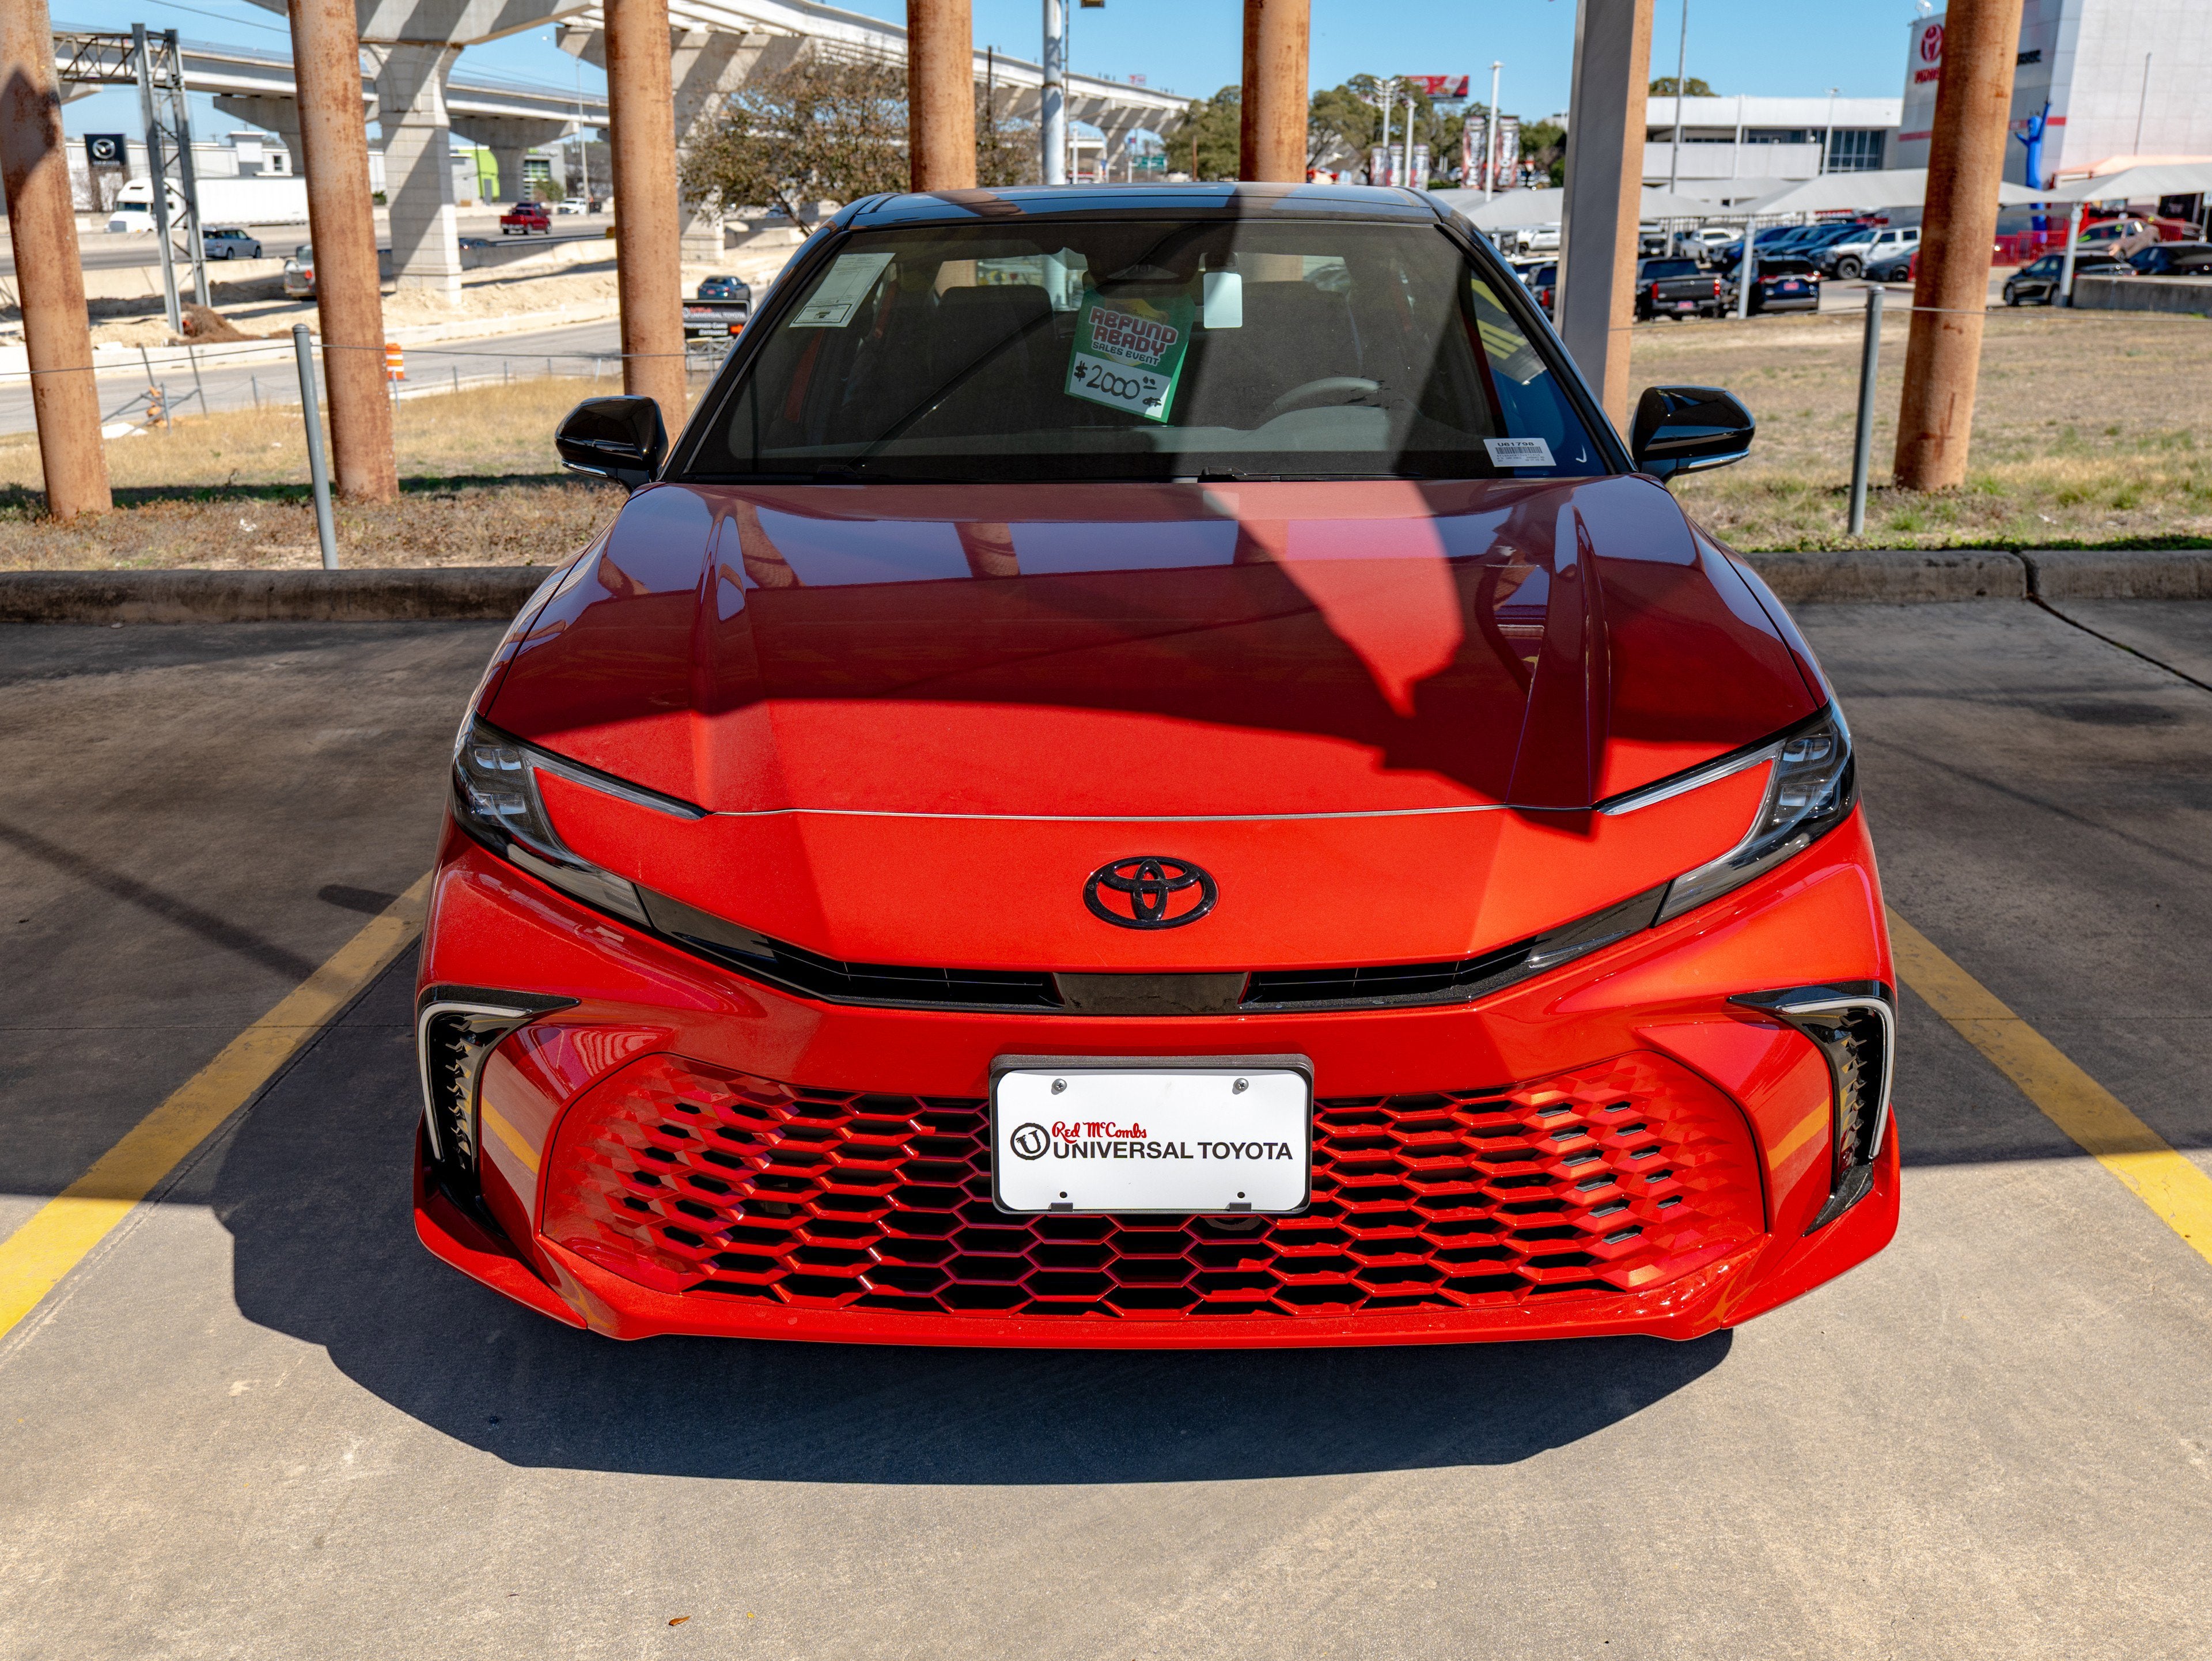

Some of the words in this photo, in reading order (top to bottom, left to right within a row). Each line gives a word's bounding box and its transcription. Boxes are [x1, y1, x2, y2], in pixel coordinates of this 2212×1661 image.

[1090, 307, 1177, 343] REFUND
[1093, 326, 1166, 357] READY
[1093, 342, 1123, 355] SALES
[1126, 350, 1160, 365] EVENT
[1052, 1121, 1081, 1144] Red
[1082, 1122, 1147, 1138] McCombs
[1054, 1141, 1194, 1159] UNIVERSAL
[1197, 1142, 1293, 1160] TOYOTA
